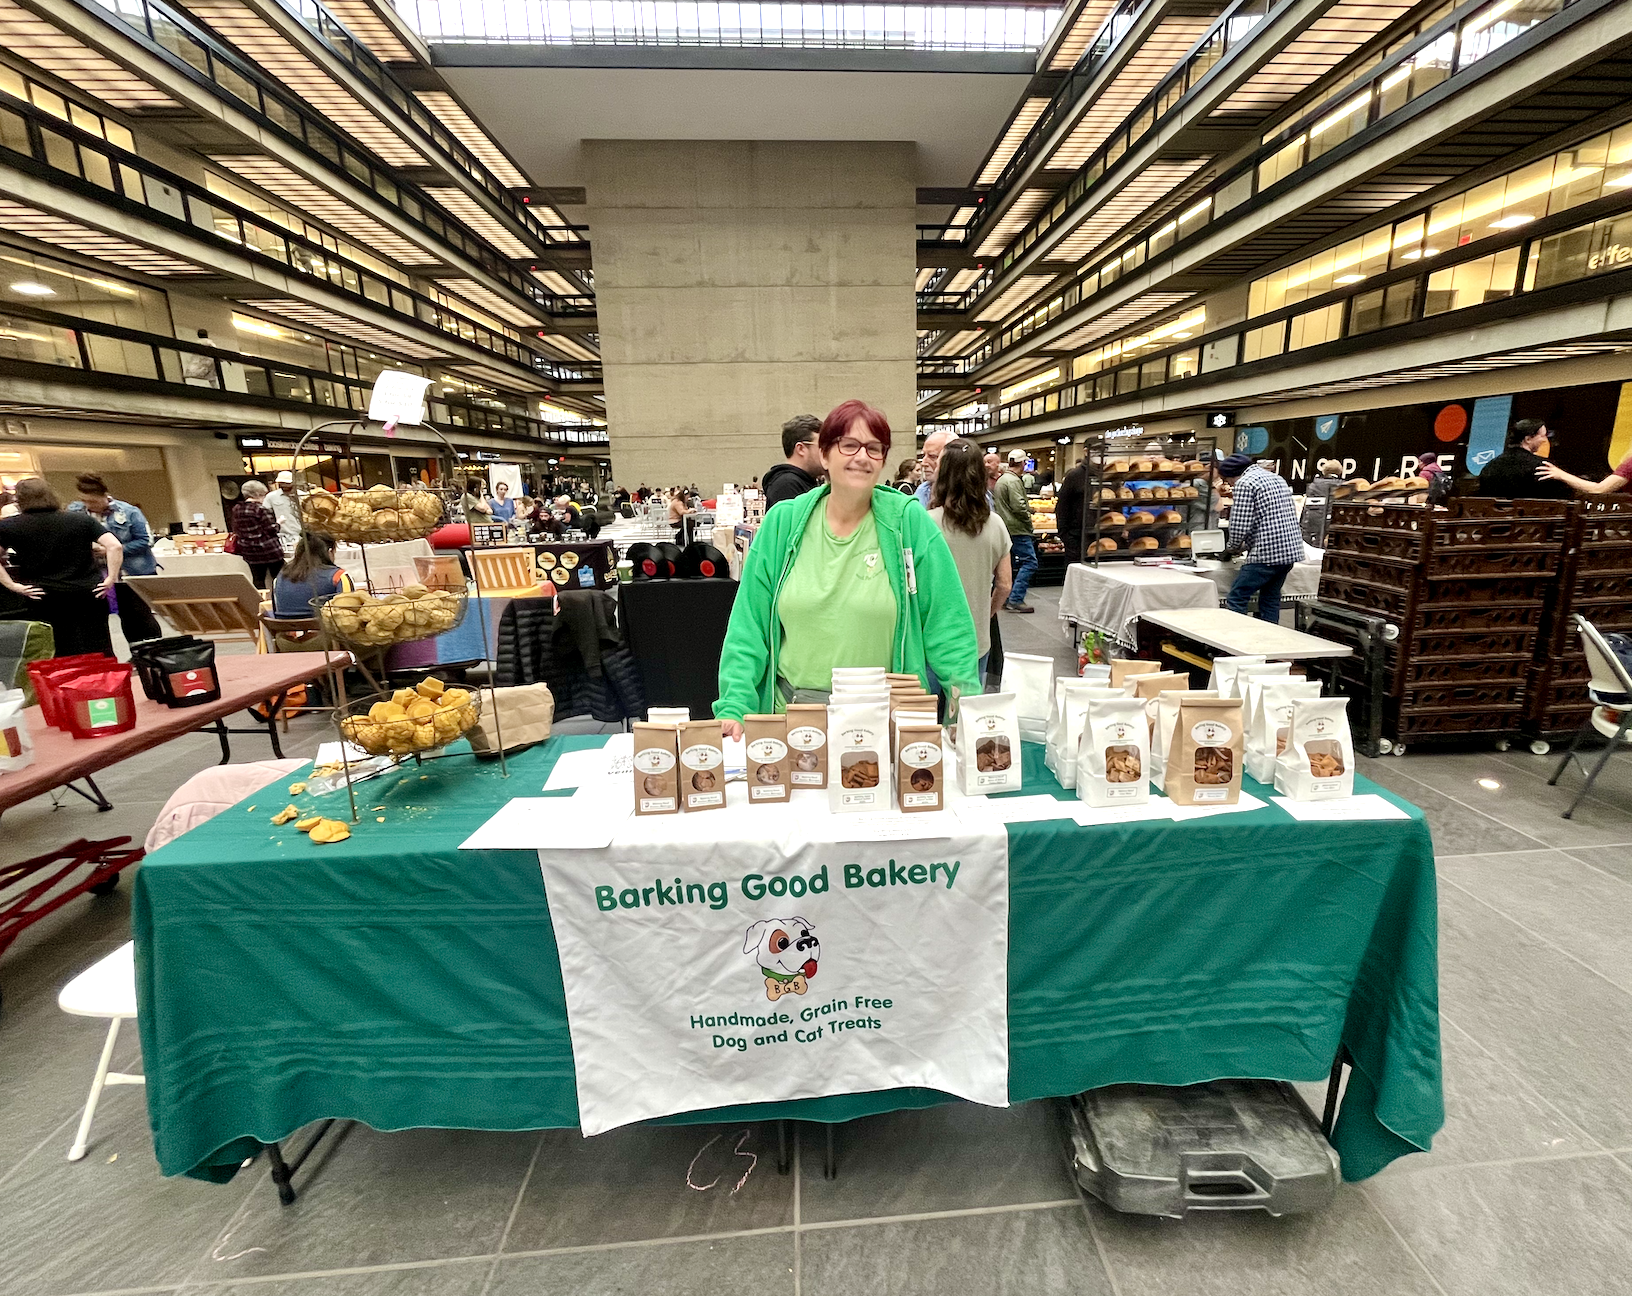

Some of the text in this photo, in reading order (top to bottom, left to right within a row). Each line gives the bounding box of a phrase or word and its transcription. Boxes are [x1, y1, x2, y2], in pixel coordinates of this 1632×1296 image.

[595, 859, 961, 911] Barking Good Bakery
[690, 996, 893, 1029] Handmade, Grain Free
[712, 1016, 882, 1052] Dog and Cat Treats
